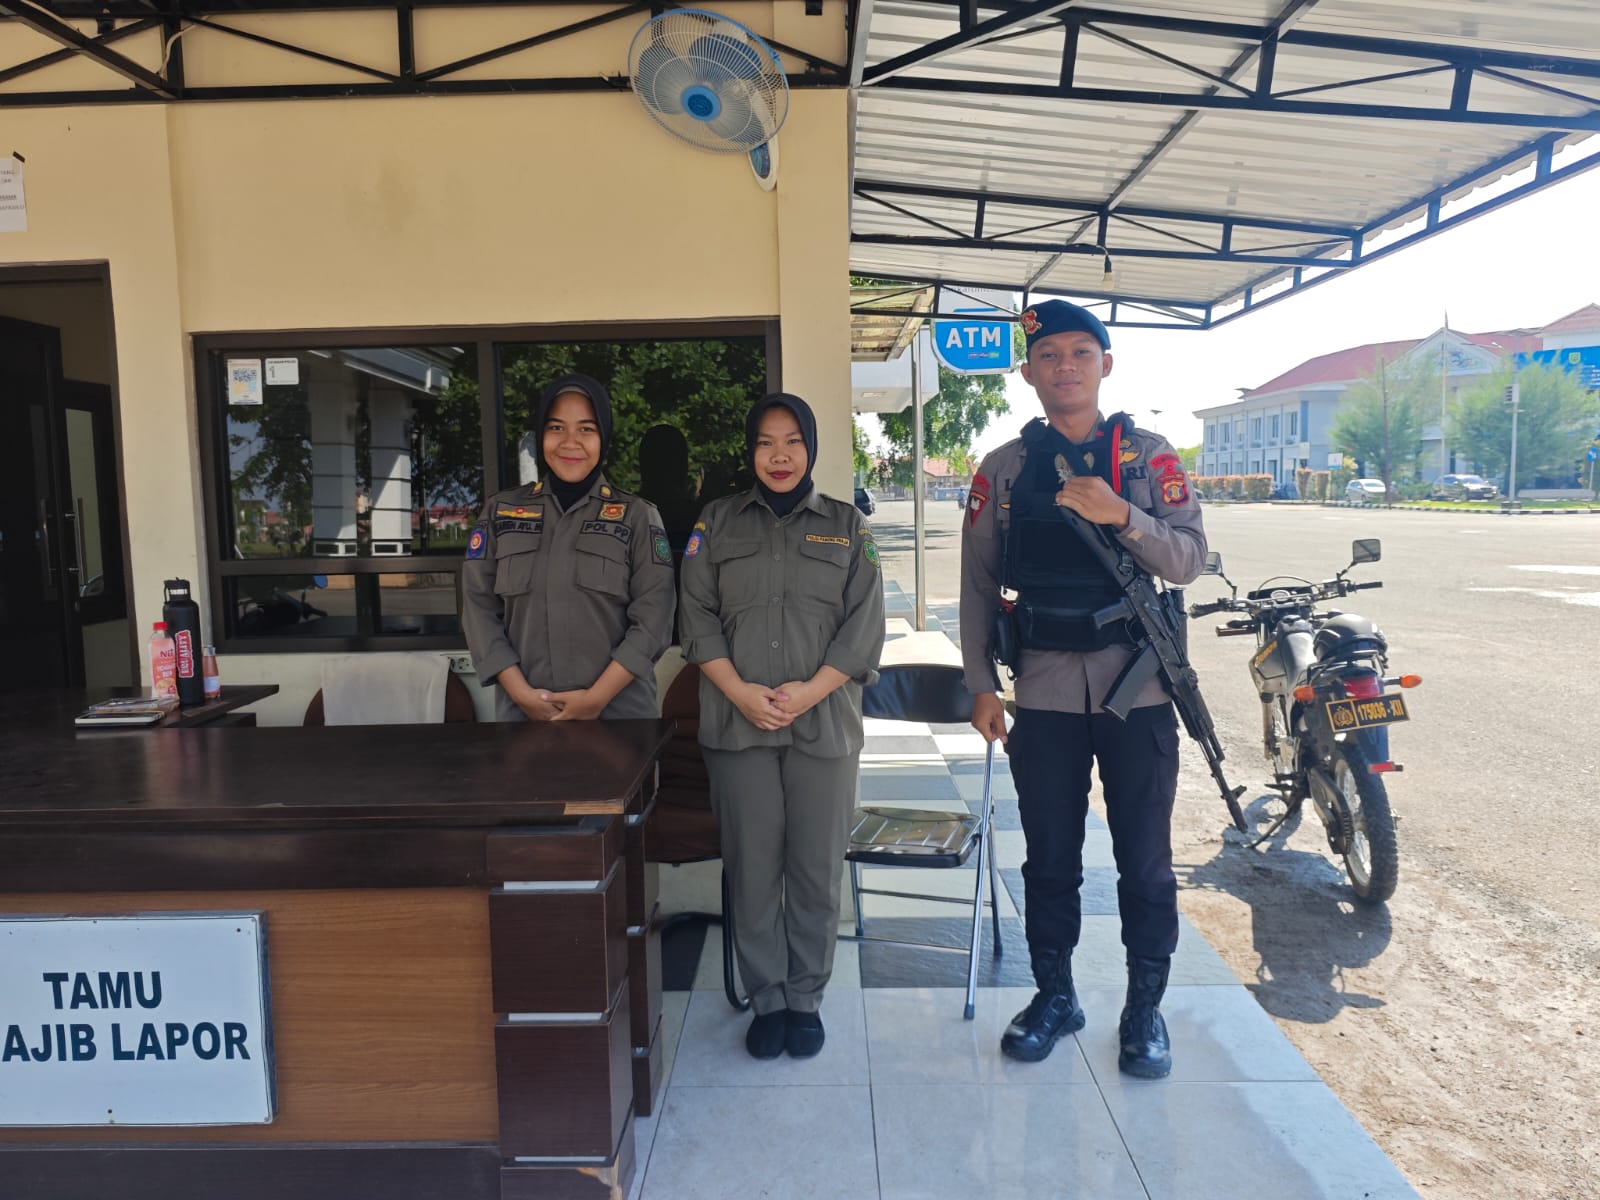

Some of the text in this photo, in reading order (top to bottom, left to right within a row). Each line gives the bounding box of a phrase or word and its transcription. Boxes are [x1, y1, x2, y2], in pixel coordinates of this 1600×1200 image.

[946, 326, 1001, 349] ATM
[585, 523, 629, 539] POL PP
[43, 971, 163, 1010] TAMU
[111, 1021, 251, 1061] LAPOR
